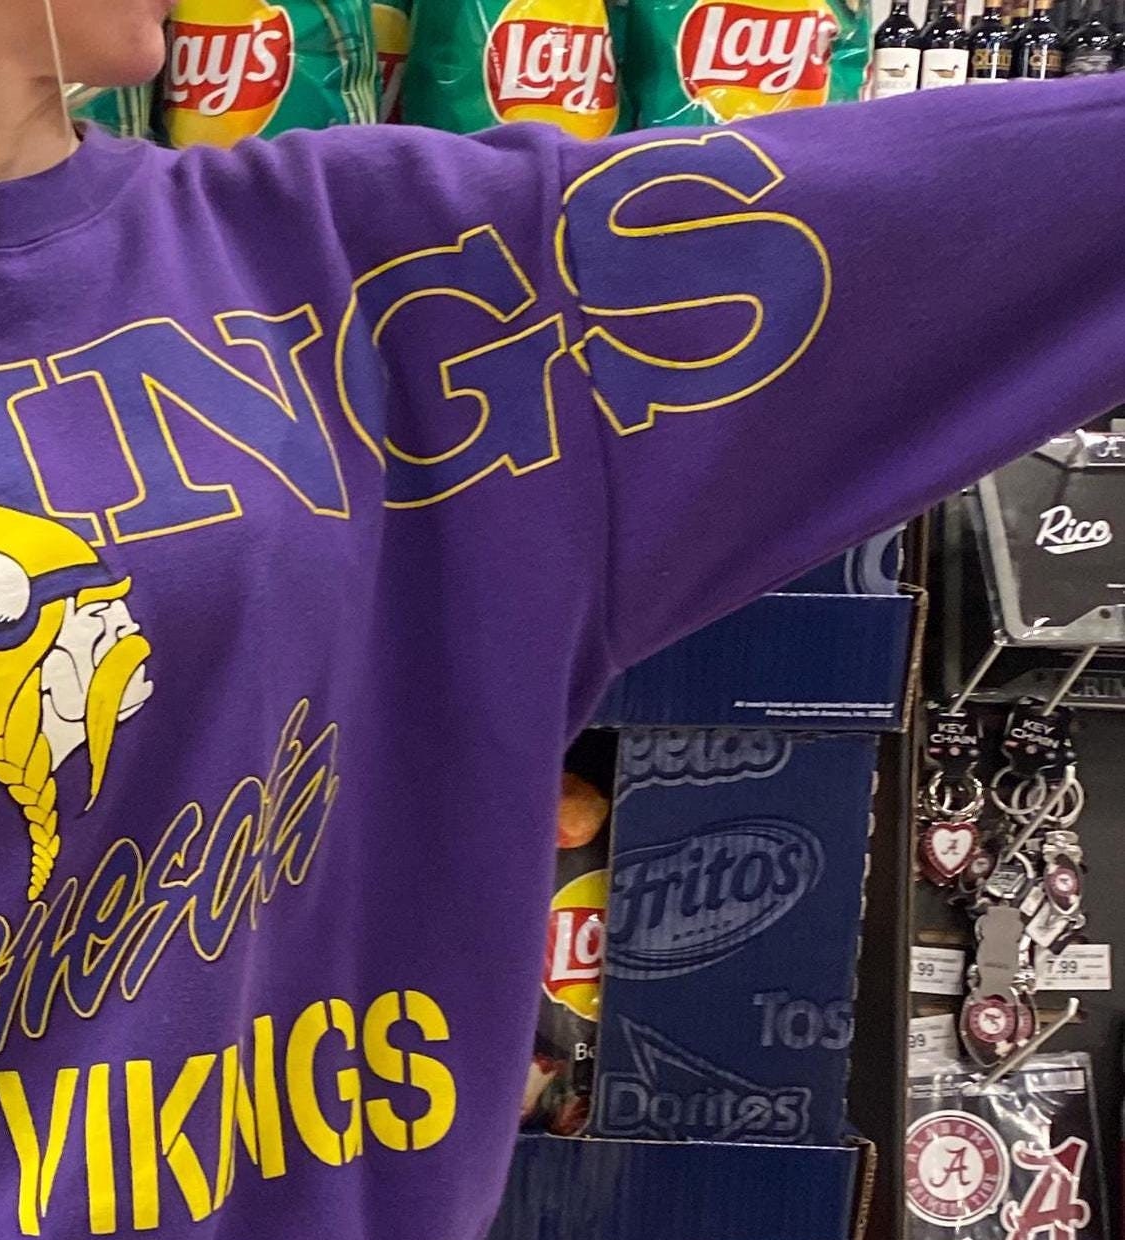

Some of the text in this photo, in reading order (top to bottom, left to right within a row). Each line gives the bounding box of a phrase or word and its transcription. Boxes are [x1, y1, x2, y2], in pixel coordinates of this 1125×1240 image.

[165, 20, 283, 116] ay's
[1035, 505, 1113, 555] Rico
[937, 723, 968, 735] KEY
[1022, 719, 1055, 735] KEY
[608, 1081, 800, 1132] Doritos
